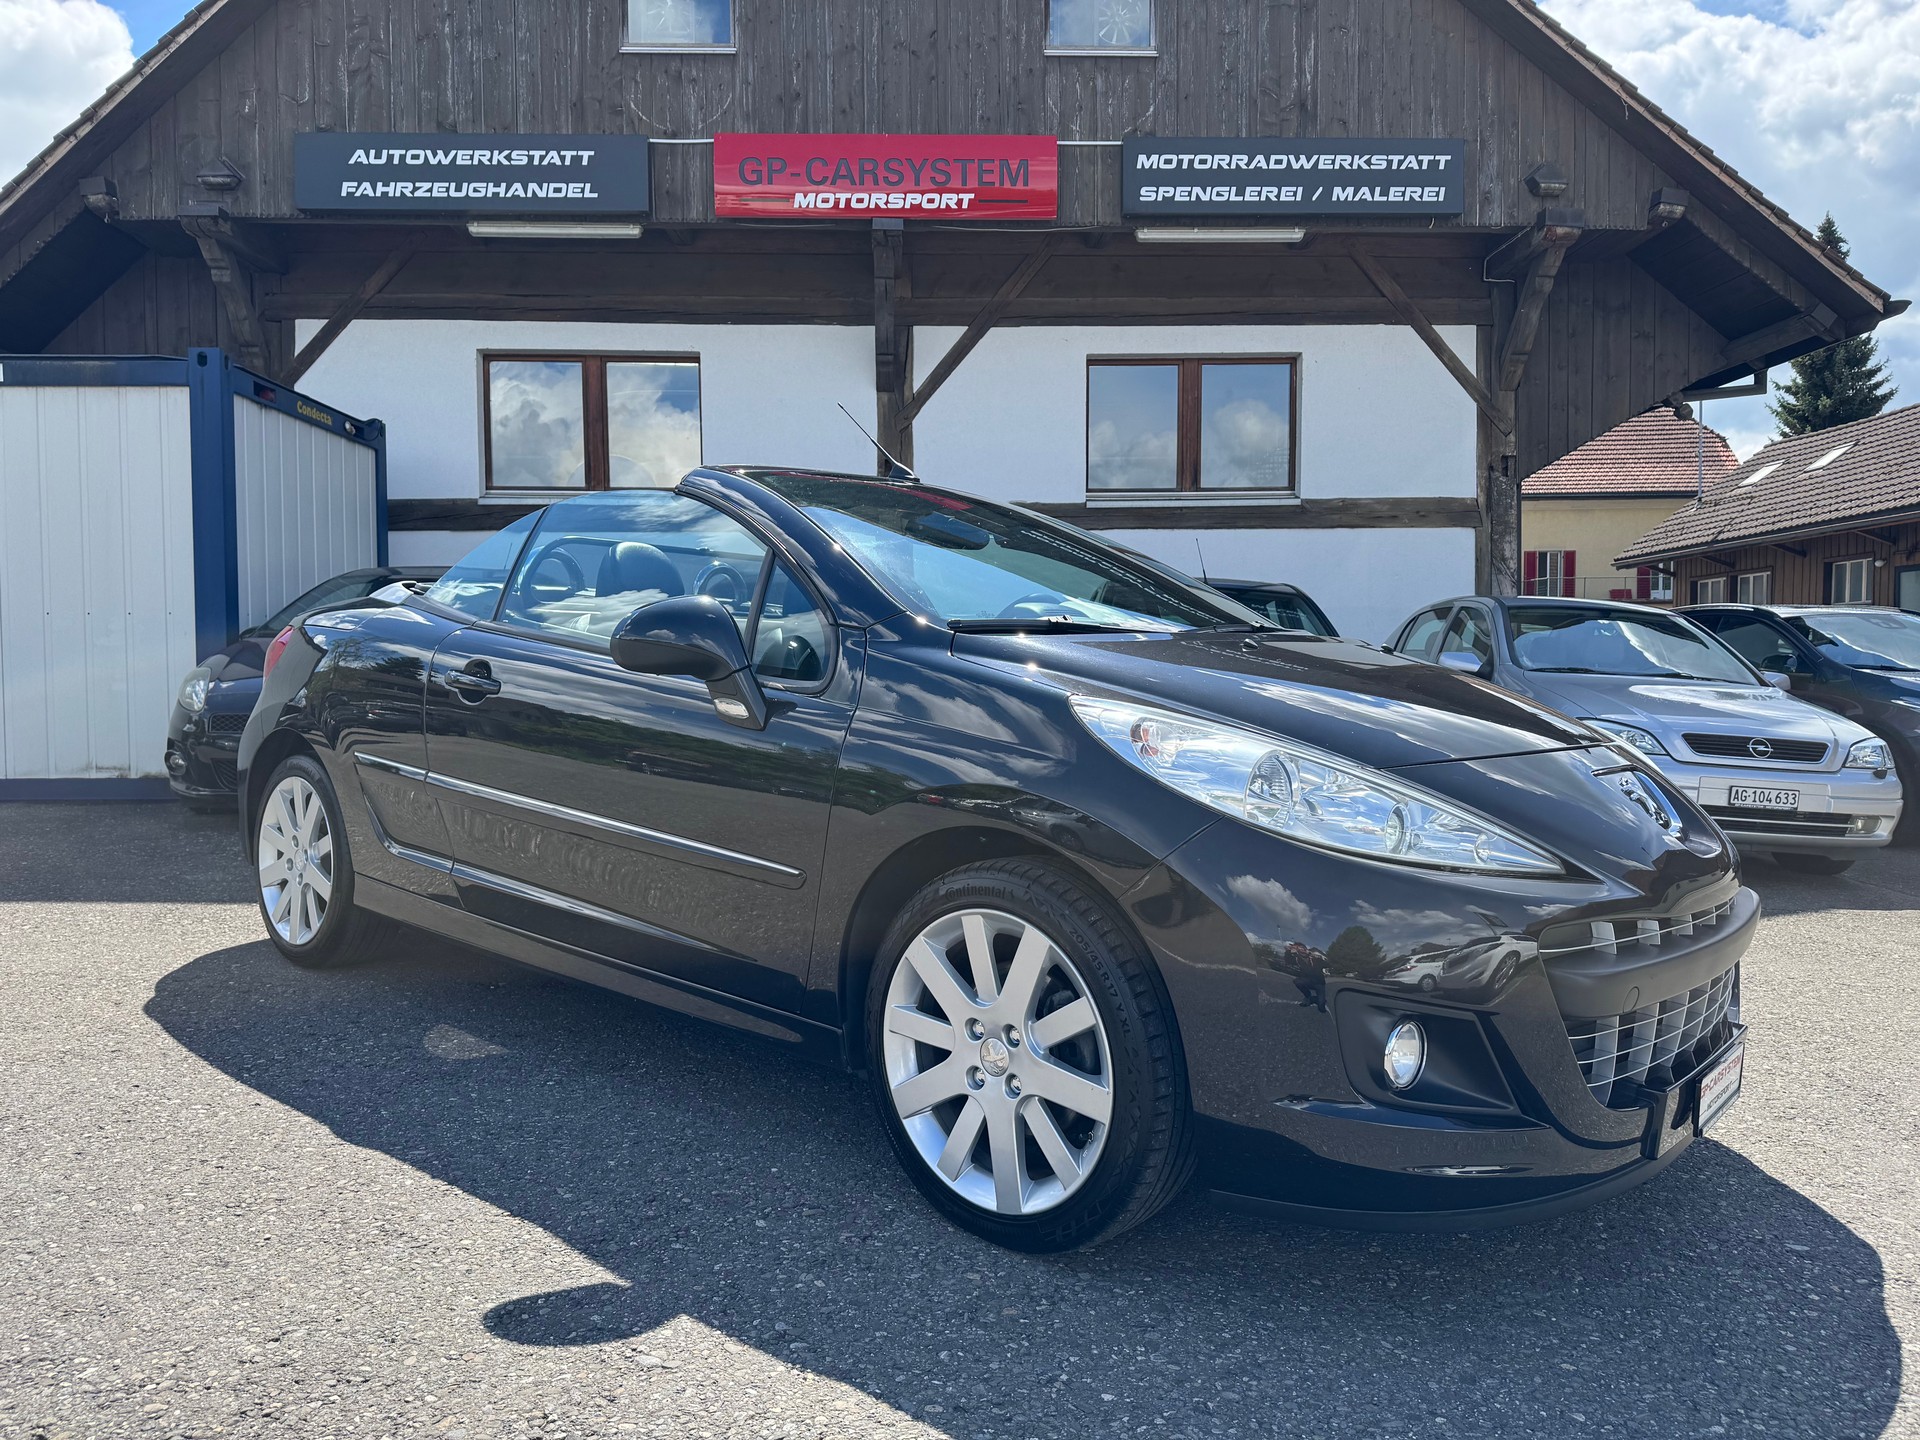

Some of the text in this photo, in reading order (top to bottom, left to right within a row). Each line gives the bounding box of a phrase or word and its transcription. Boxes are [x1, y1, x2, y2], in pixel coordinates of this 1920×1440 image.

[347, 149, 595, 165] AUTOWERKSTATT
[1136, 154, 1452, 170] MOTORRADWERKSTATT
[738, 156, 1030, 188] GP-CARSYSTEM
[340, 181, 599, 199] FAHRZEUGHANDEL
[1139, 186, 1446, 202] SPENGLEREI / MALEREI
[792, 192, 975, 209] MOTORSPORT
[297, 400, 332, 425] Condecta
[945, 883, 1007, 902] Continental
[1068, 927, 1105, 971] 205/45
